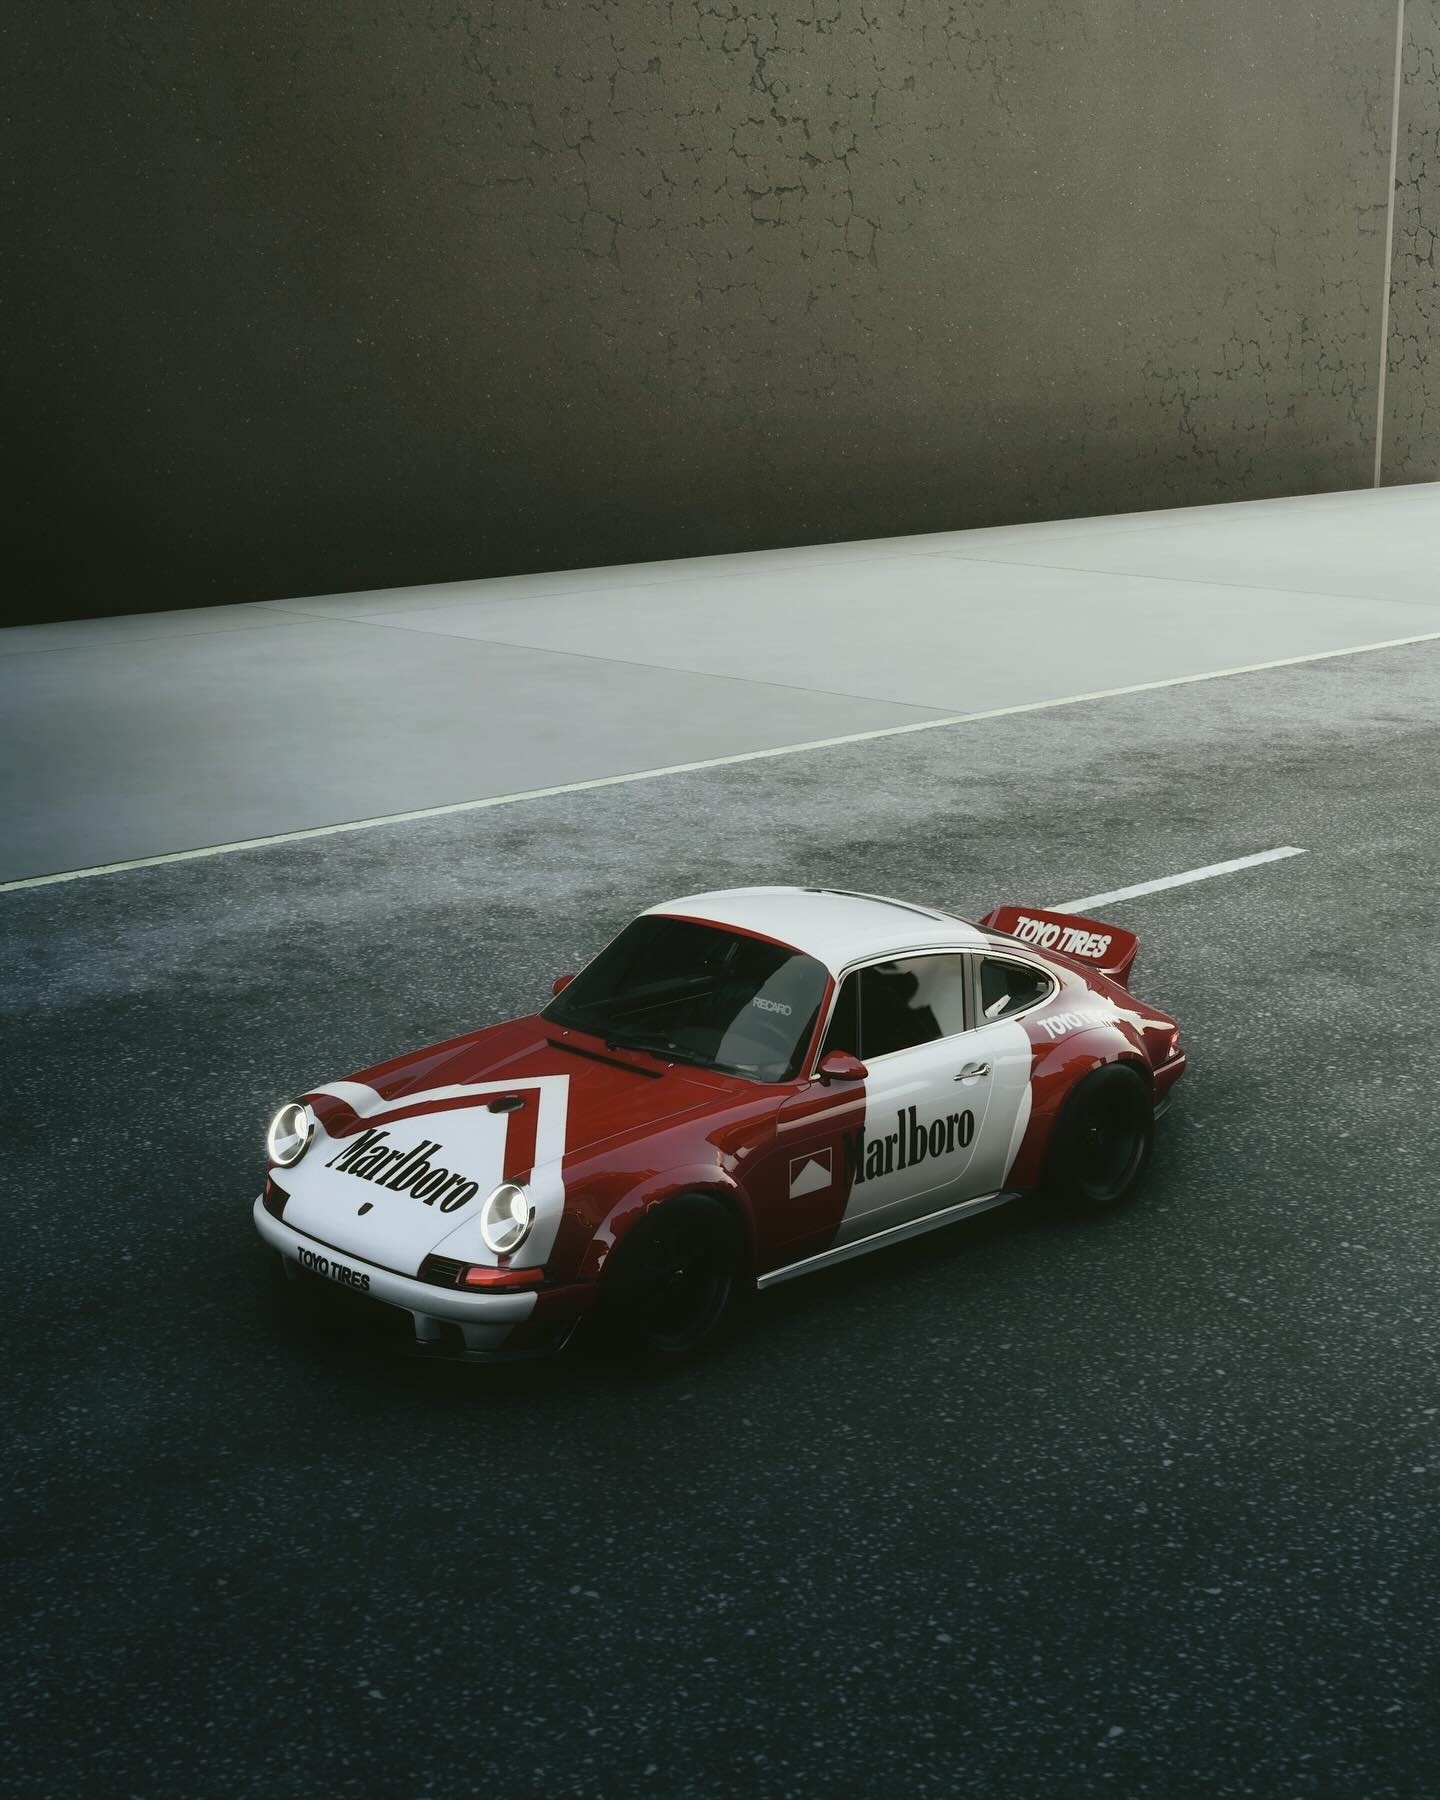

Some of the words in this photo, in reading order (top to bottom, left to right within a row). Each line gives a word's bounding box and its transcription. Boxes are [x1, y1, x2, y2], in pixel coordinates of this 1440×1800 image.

[1012, 916, 1060, 949] TOYO
[1056, 927, 1112, 958] TIRES
[752, 996, 792, 1017] RECARO
[1037, 1012, 1083, 1039] TOYO
[324, 1128, 479, 1213] Marlboro
[297, 1246, 329, 1275] TOYO
[331, 1261, 371, 1291] TIRES
